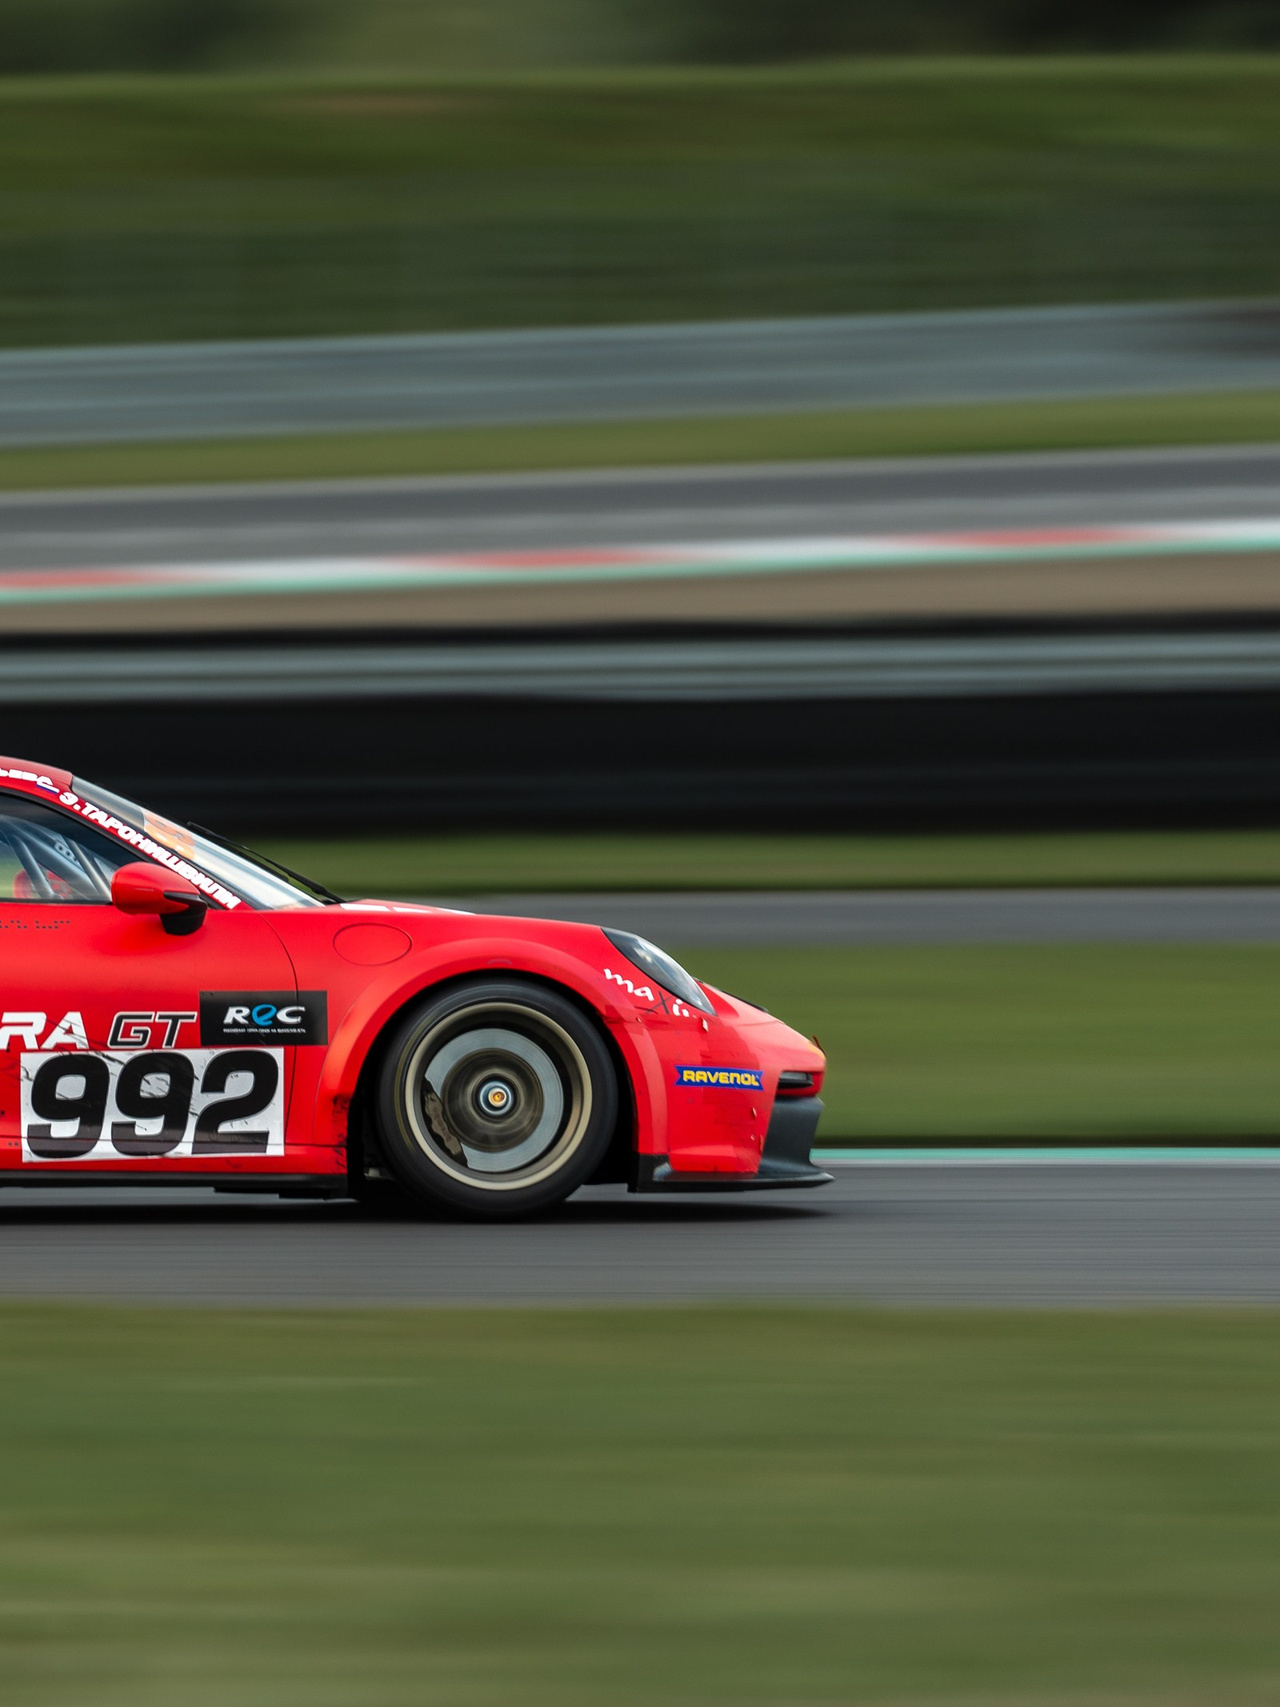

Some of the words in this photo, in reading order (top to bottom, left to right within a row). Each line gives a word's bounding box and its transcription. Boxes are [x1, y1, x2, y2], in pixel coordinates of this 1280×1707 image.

[106, 1011, 198, 1050] GT
[682, 1069, 761, 1087] RAVENOL
[26, 1049, 279, 1159] 992
